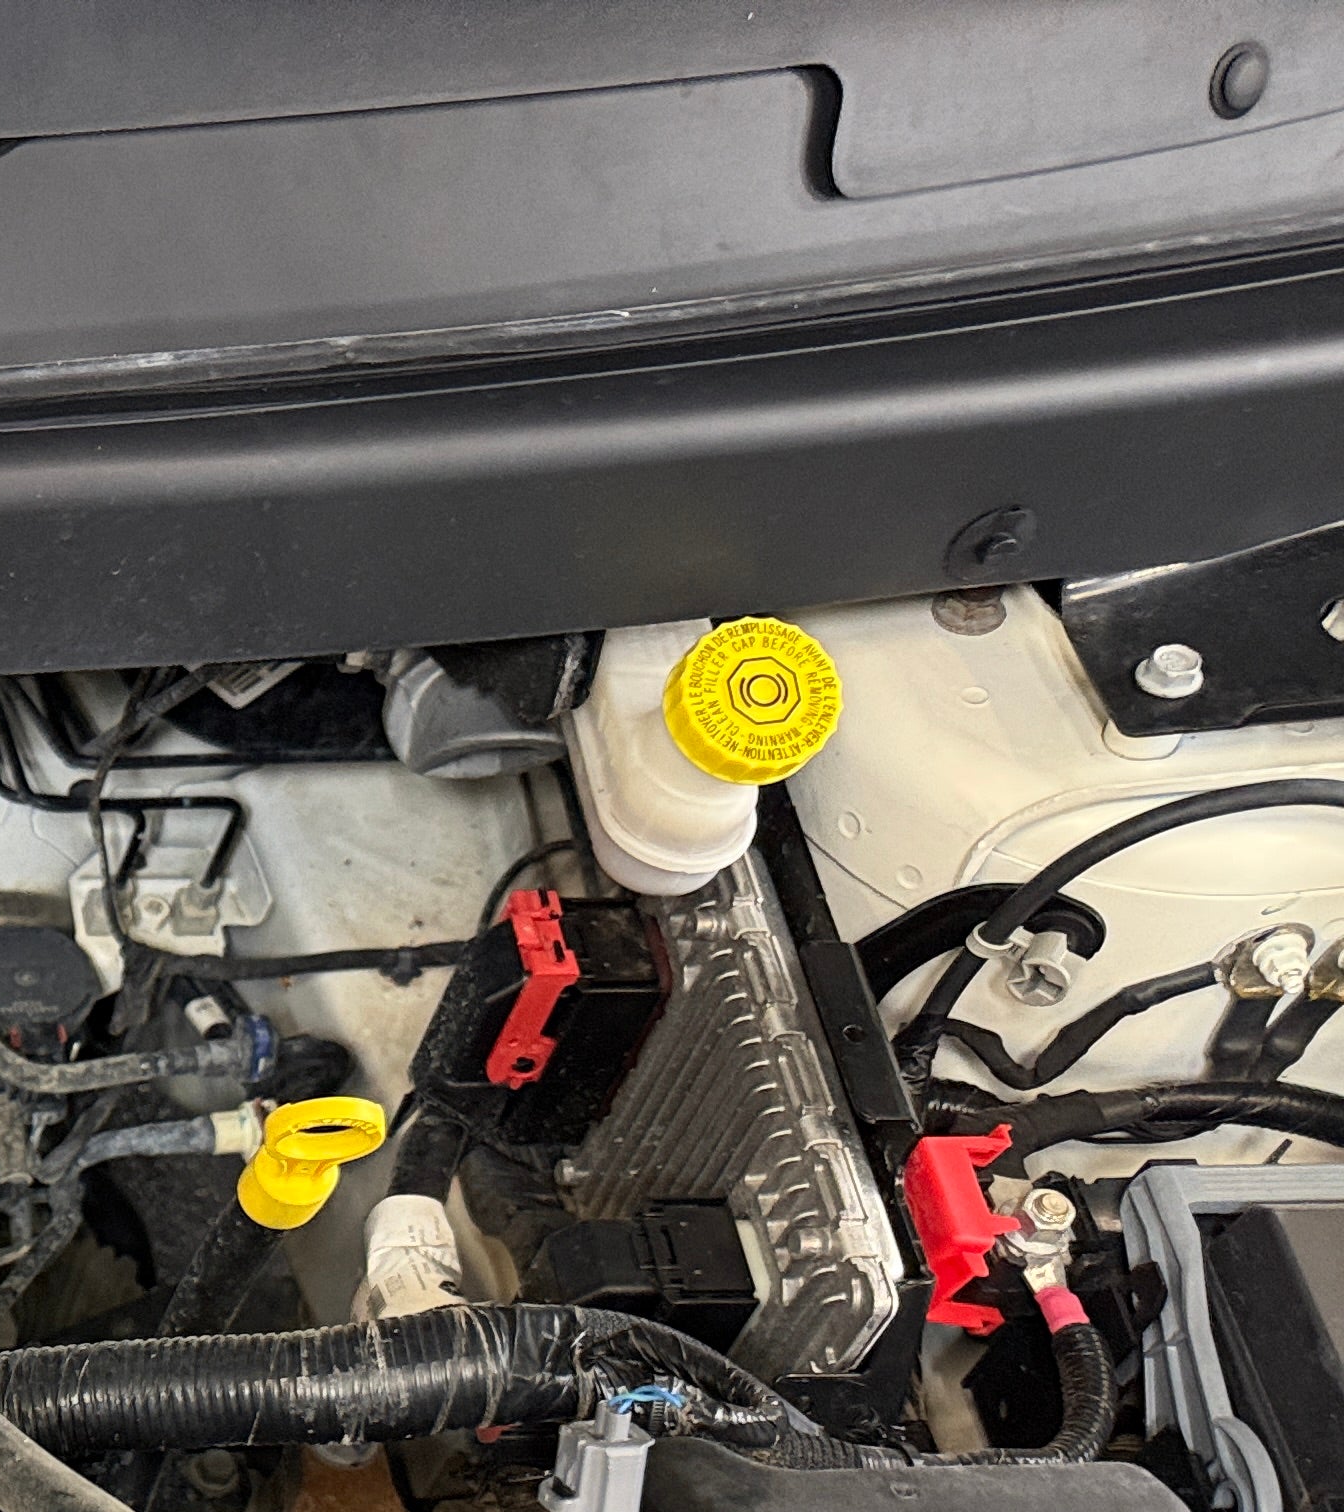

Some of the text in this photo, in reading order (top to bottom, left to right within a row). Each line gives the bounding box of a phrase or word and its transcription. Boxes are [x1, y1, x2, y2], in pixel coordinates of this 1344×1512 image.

[712, 631, 729, 647] DE
[726, 622, 803, 645] REMPLISSAGE
[731, 635, 757, 653] CAP
[761, 635, 812, 669] BEFORE
[802, 643, 832, 672] AVANT
[689, 643, 715, 689] BOUCHON
[703, 651, 729, 694] FILLER
[821, 676, 837, 691] DE
[688, 691, 705, 706] LE
[707, 699, 740, 737] CLEAN
